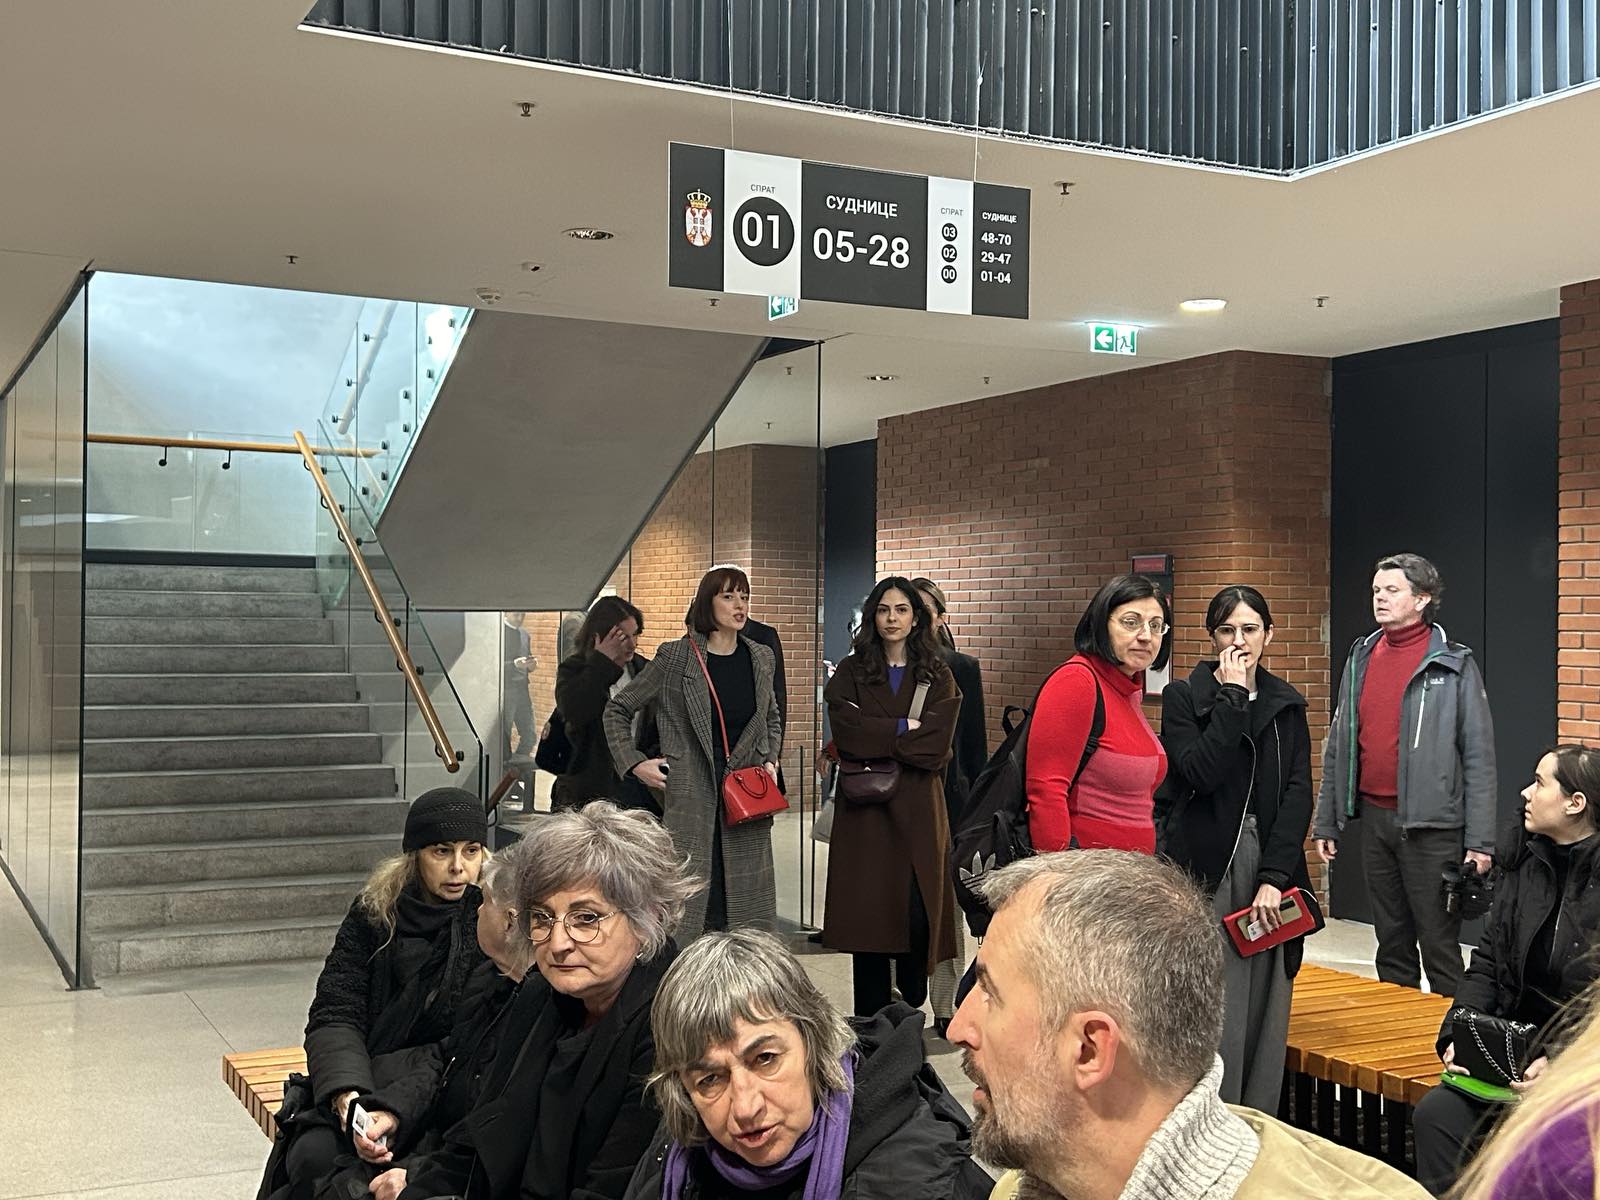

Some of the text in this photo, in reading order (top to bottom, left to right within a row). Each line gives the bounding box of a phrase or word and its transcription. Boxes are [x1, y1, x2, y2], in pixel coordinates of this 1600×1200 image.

[750, 184, 776, 194] СПРАТ
[826, 195, 898, 219] СУДНИЦЕ
[940, 207, 964, 217] СПРАТ
[981, 211, 1017, 223] СУДНИЦЕ
[741, 211, 780, 250] 01
[943, 226, 956, 238] 03
[980, 232, 1012, 246] 48-70
[813, 227, 910, 269] 05-28
[943, 247, 956, 259] 02
[980, 251, 1012, 265] 29-47
[942, 268, 956, 280] 00
[980, 270, 1012, 284] 01-04
